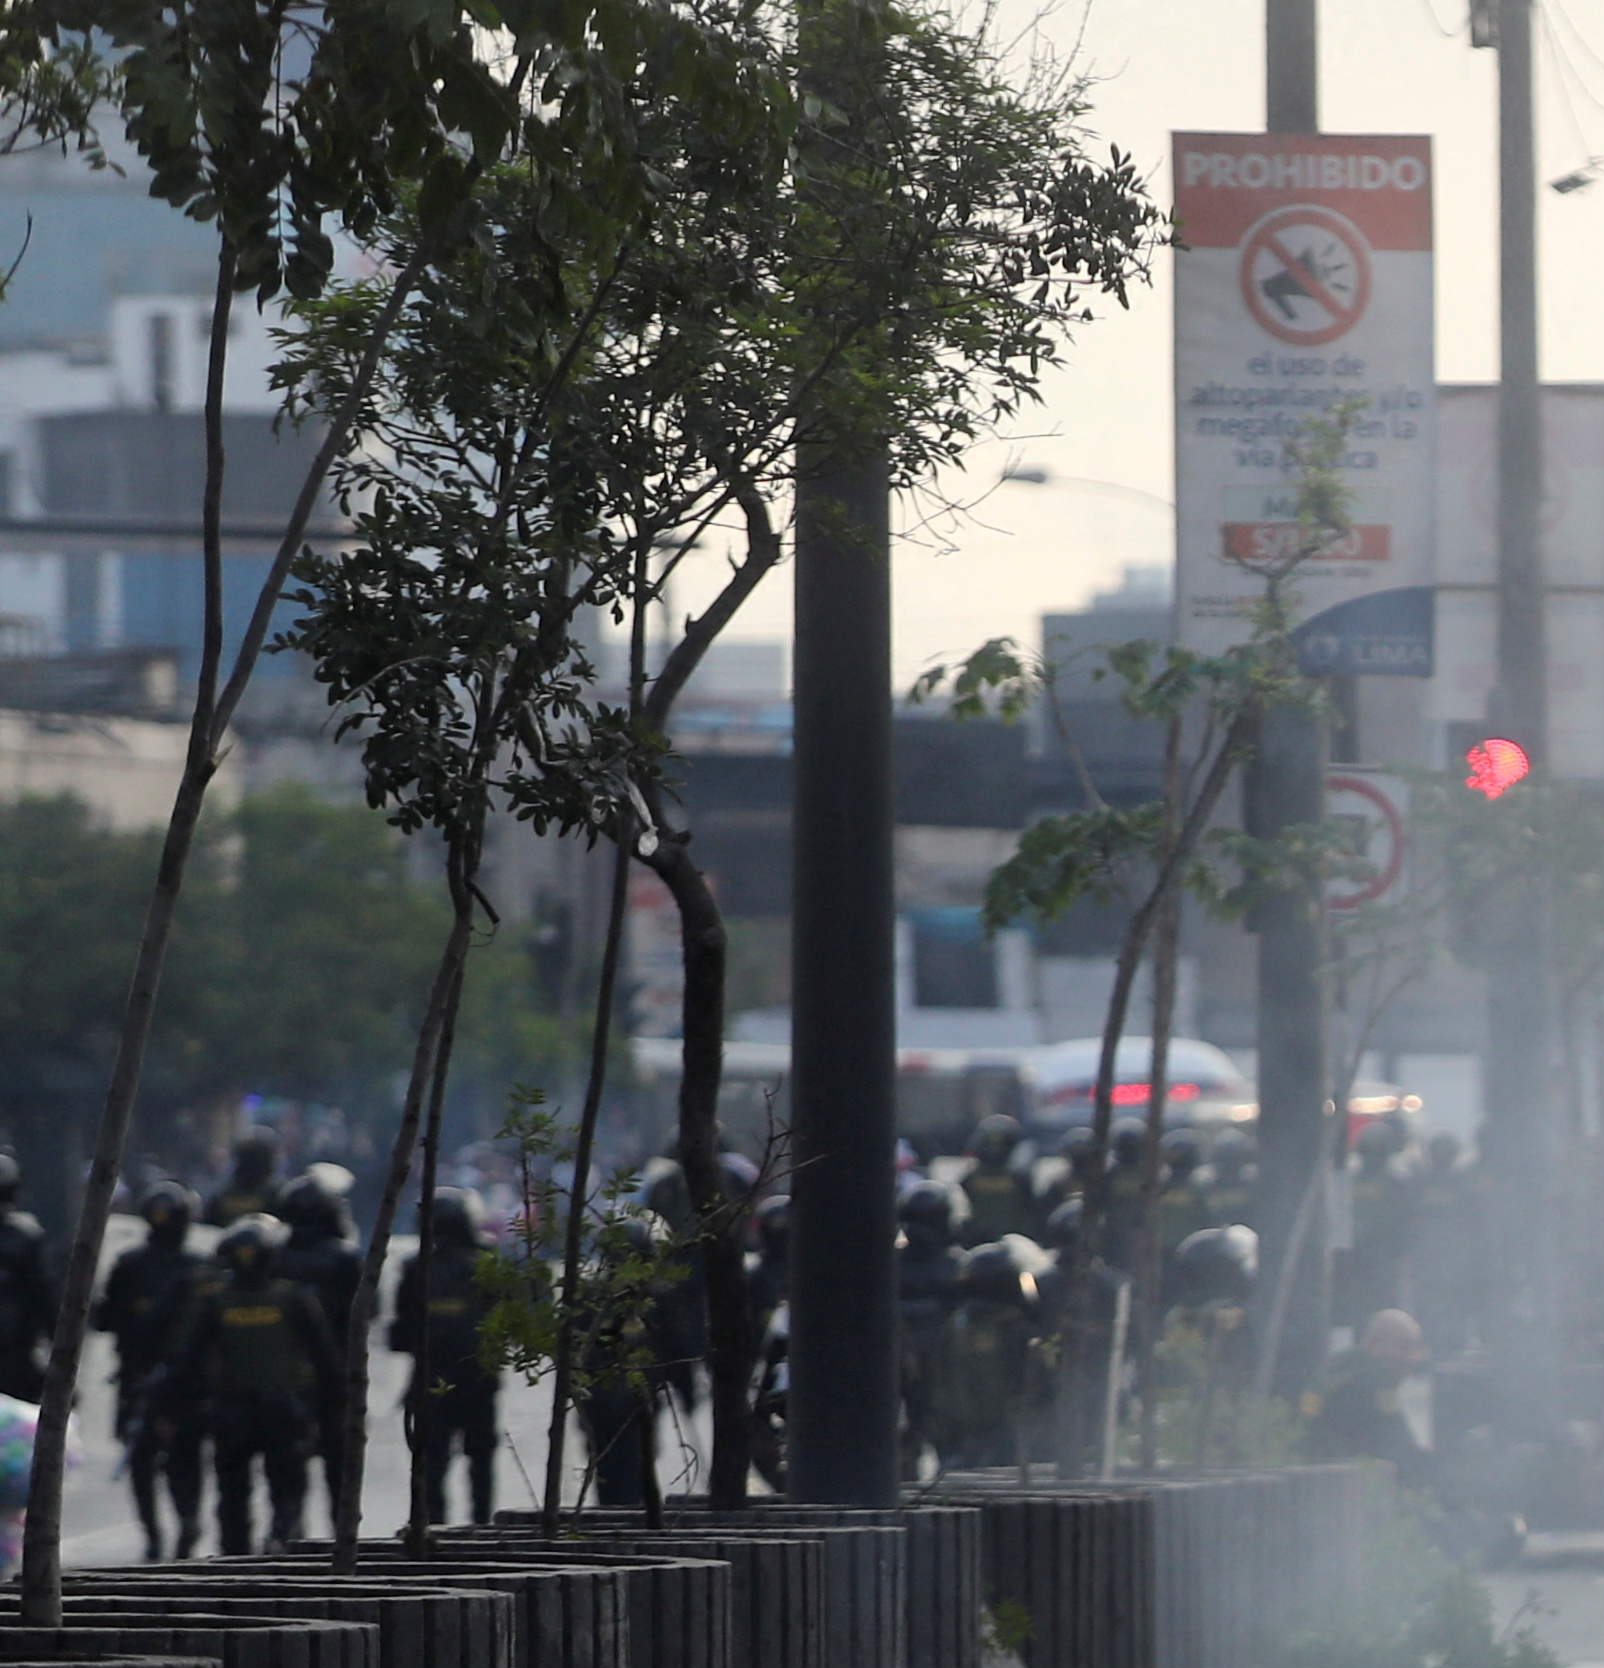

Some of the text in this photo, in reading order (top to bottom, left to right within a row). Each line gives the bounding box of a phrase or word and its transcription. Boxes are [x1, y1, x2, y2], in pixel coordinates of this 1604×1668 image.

[1184, 151, 1427, 190] PROHIBIDO
[1276, 358, 1327, 376] uso
[1331, 350, 1367, 376] de
